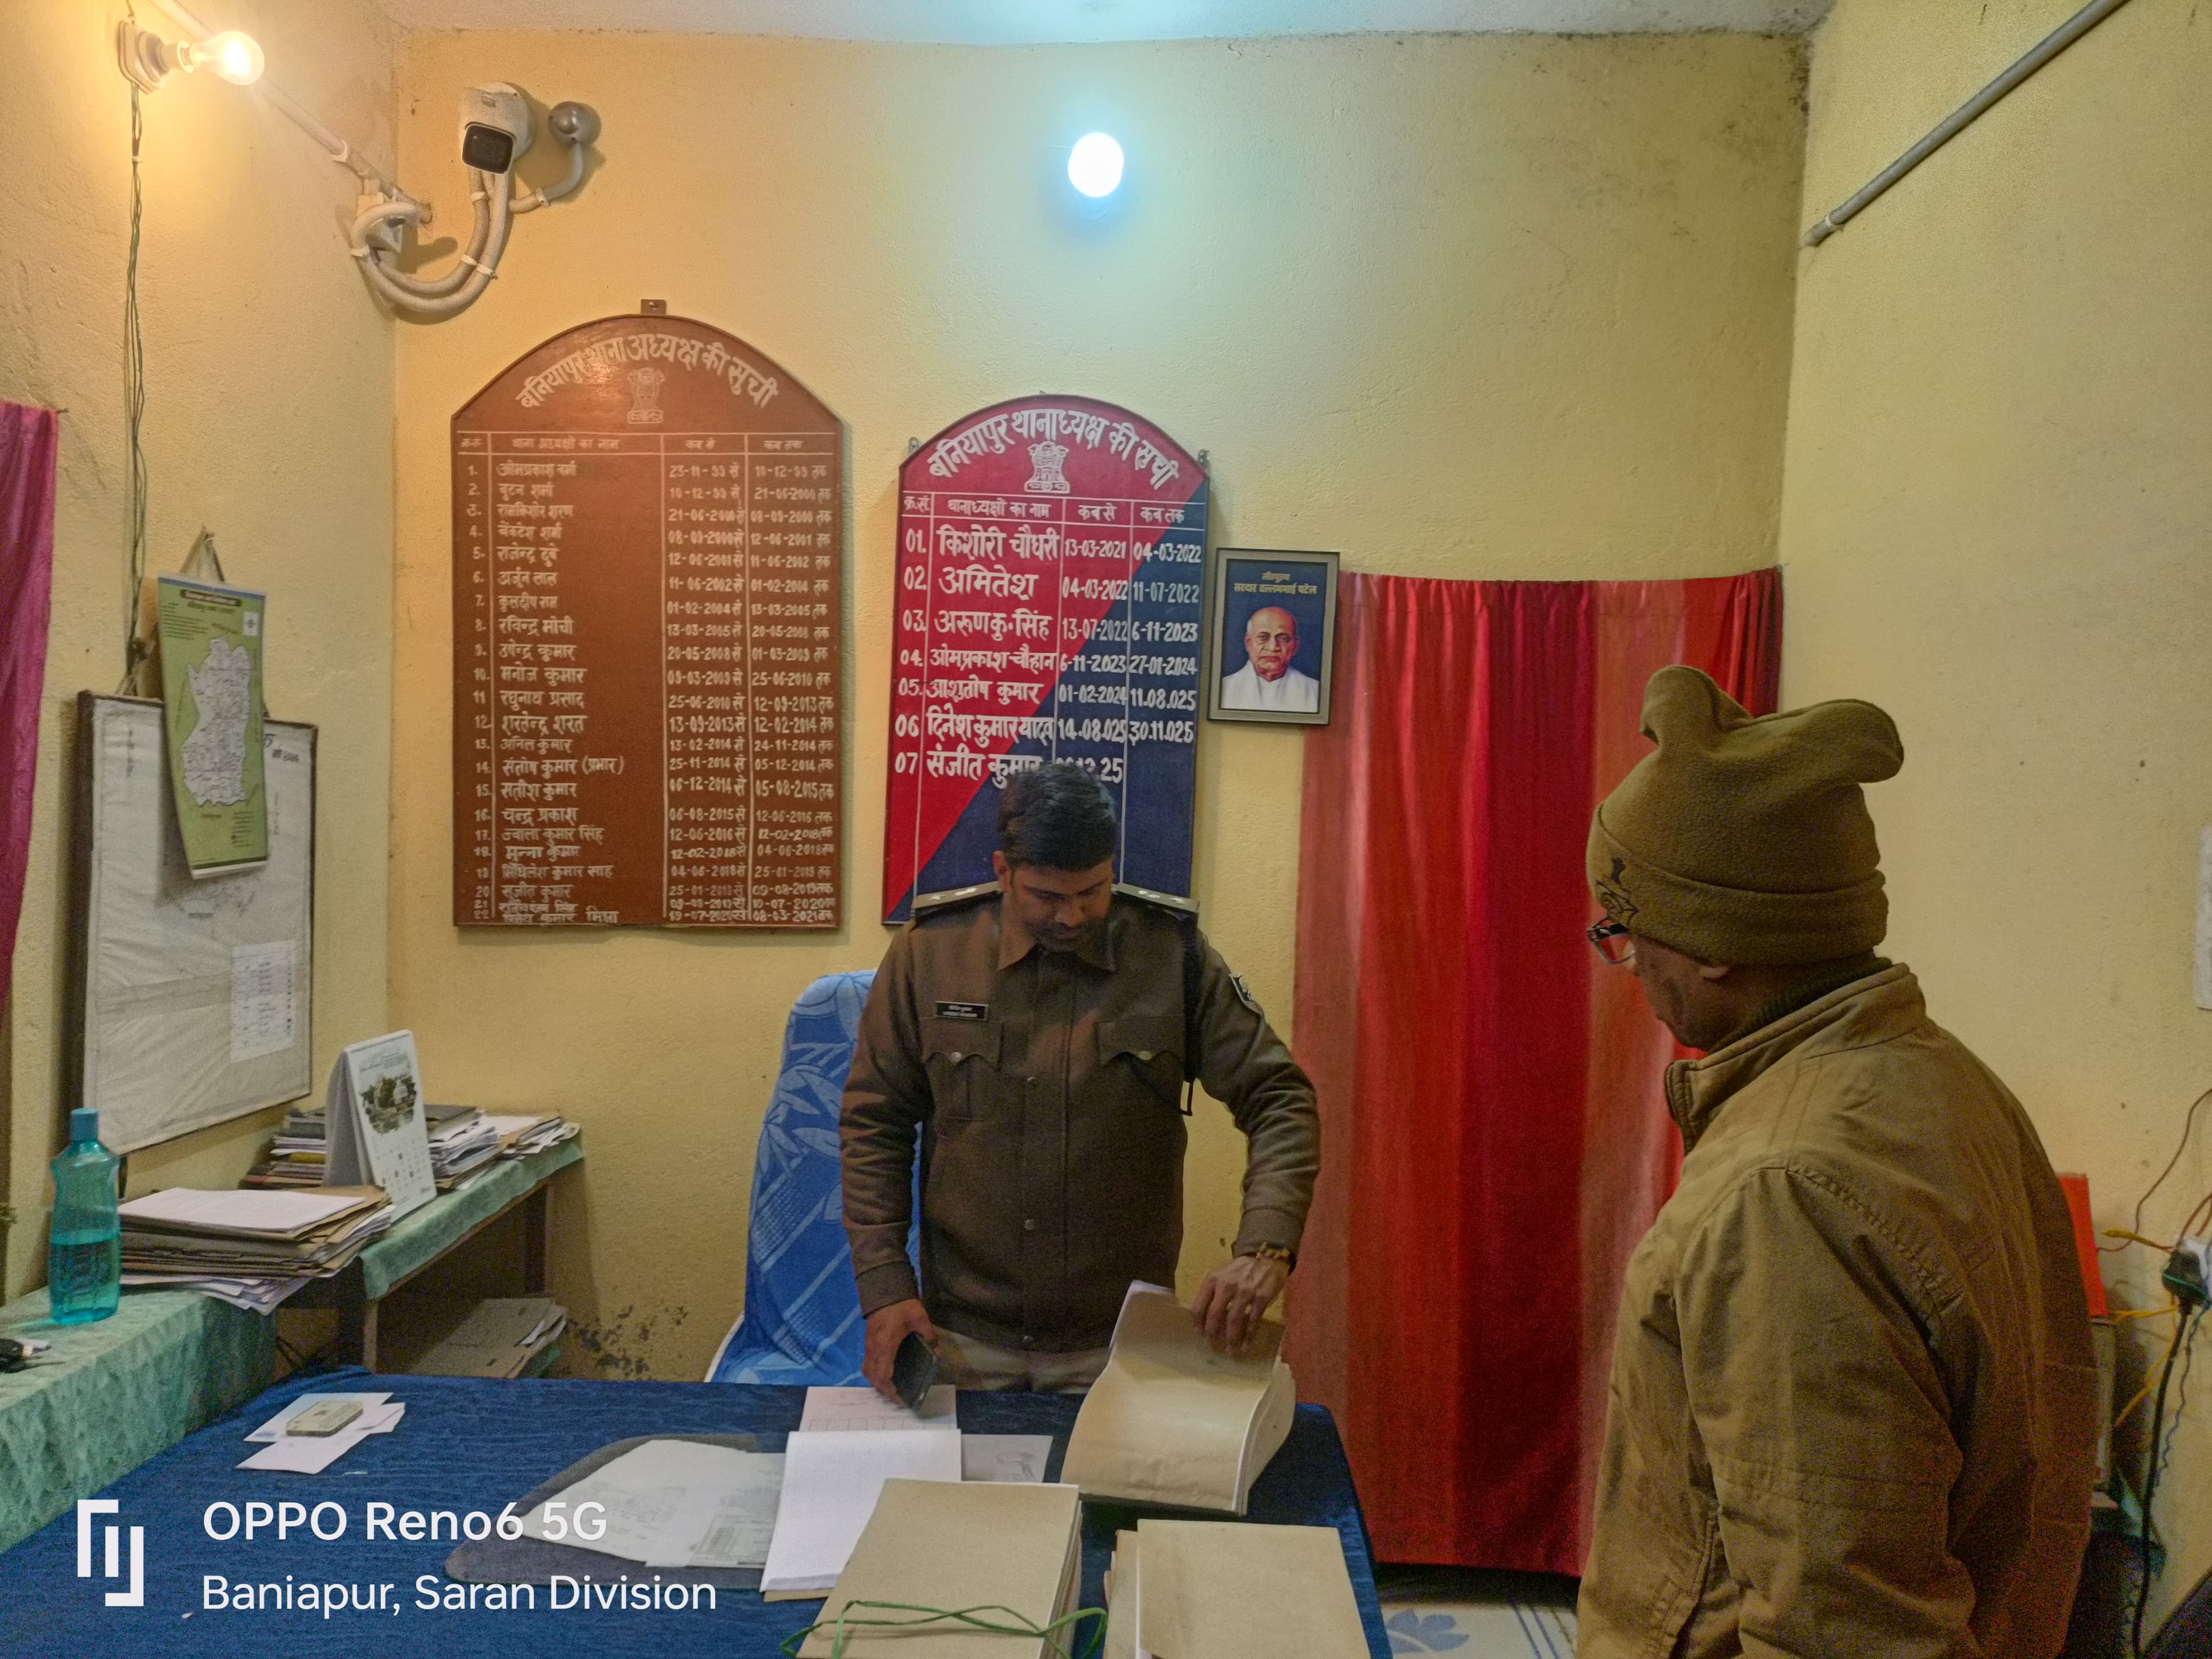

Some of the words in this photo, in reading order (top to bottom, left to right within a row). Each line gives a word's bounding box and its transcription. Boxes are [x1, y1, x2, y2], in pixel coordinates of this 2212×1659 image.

[628, 334, 705, 370] अध्यक्ष
[702, 342, 732, 376] की
[927, 414, 1015, 477] बनियापुर
[1012, 409, 1109, 449] थानाध्यक्ष
[1109, 423, 1139, 460] की
[1010, 502, 1026, 516] का
[1029, 503, 1051, 518] नाम
[1140, 507, 1162, 523] कब
[1164, 508, 1185, 523] तक
[936, 525, 1007, 560] किशोरी
[1010, 524, 1060, 561] चौधरी
[1065, 538, 1127, 559] 13-03-2021
[1134, 539, 1202, 564] 04-03-2022
[939, 564, 1039, 600] अमितेश
[1062, 577, 1128, 601] 04-03-2022
[1133, 583, 1199, 604] 11-07-2022
[1062, 618, 1128, 641] 13-07-2022
[1132, 621, 1198, 642] 6-11-2023
[537, 644, 576, 662] कुमार
[1060, 653, 1127, 673] 6-11-2023
[1129, 655, 1198, 676] 27-01-2024
[500, 662, 538, 682] मनोज
[543, 668, 588, 685] कुमार
[499, 690, 545, 711] रघुनाथ
[549, 692, 585, 708] प्रसाद
[925, 674, 993, 702] आशुतोष
[997, 682, 1044, 705] कुमार
[1059, 684, 1128, 706] 01-02-2024
[1130, 688, 1196, 711] 11.08.025
[894, 714, 919, 738] 06
[926, 702, 975, 741] दिनेश
[974, 715, 1020, 748] कुमार
[1128, 720, 1194, 746] 30.11.025
[537, 739, 574, 755] कुमार
[541, 759, 579, 778] कुमार
[895, 752, 918, 774] 07
[926, 743, 986, 781] संजीत
[500, 780, 542, 801] सतीश
[543, 783, 577, 800] कुमार
[501, 808, 535, 825] चन्द्र
[538, 808, 579, 826] प्रकाश
[543, 828, 576, 845] कुमार
[579, 825, 605, 845] सिंह
[552, 866, 585, 880] कुमार
